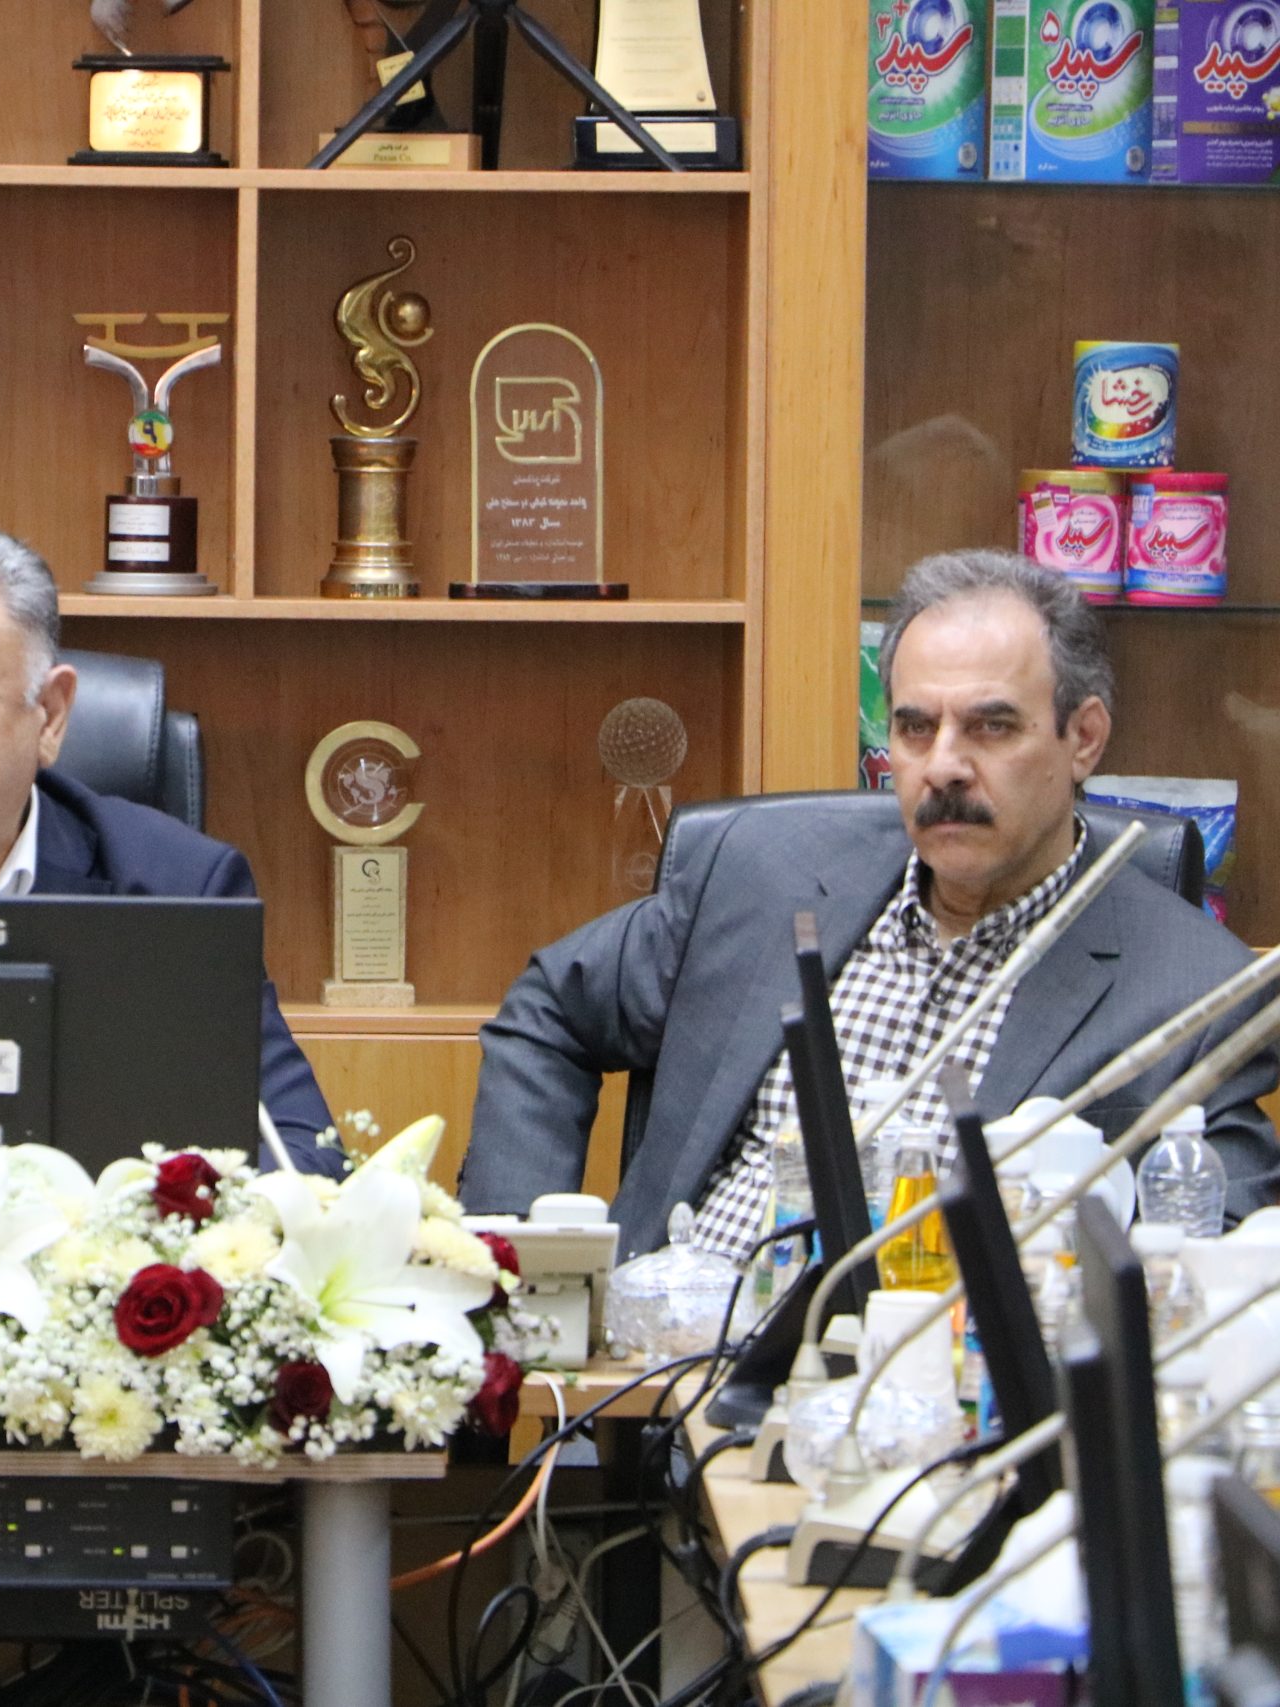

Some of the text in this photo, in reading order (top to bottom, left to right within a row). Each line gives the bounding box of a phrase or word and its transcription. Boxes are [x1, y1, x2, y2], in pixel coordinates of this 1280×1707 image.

[876, 25, 973, 93] سپید
[1047, 31, 1144, 100] سپید
[1057, 517, 1112, 560] سپید
[1146, 521, 1211, 563] سپید
[78, 1589, 192, 1611] SPLITER
